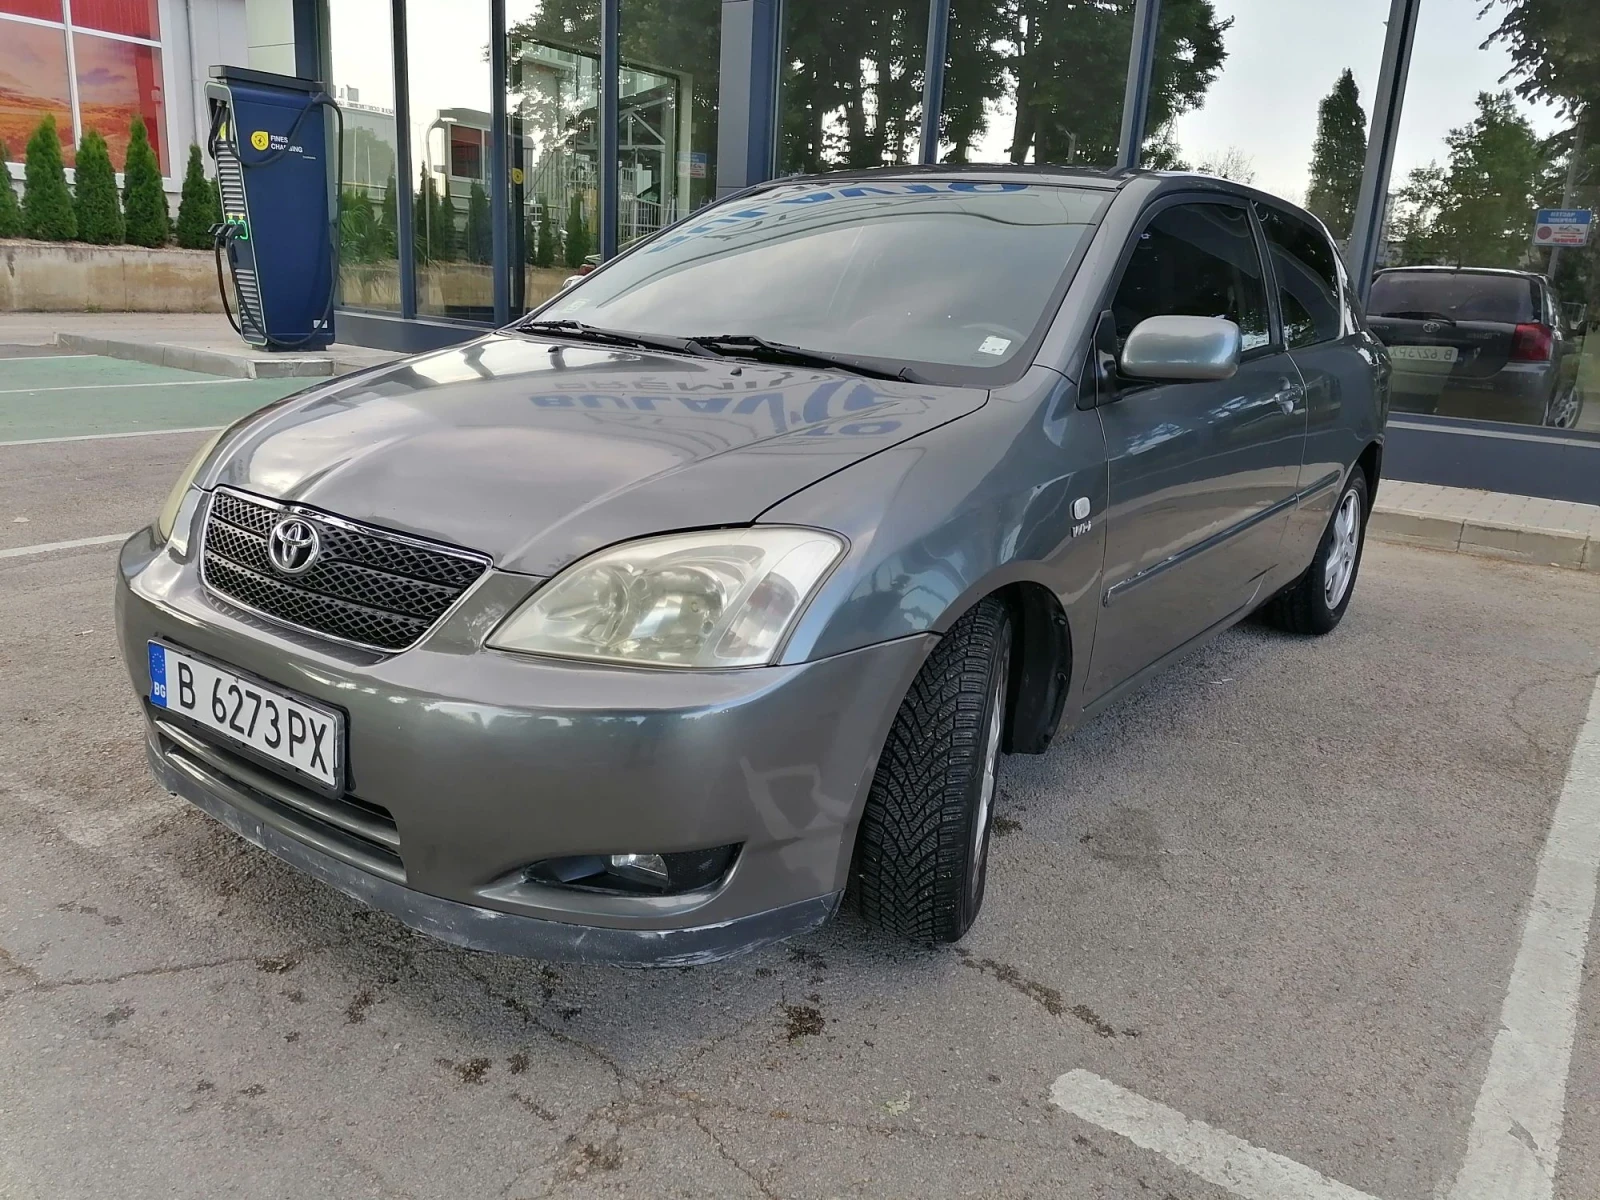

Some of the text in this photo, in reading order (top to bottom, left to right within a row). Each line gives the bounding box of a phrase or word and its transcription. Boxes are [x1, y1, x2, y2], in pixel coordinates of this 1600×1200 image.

[270, 134, 289, 143] FINES
[270, 143, 303, 153] CHAING
[154, 682, 166, 698] BG
[178, 661, 196, 710] B
